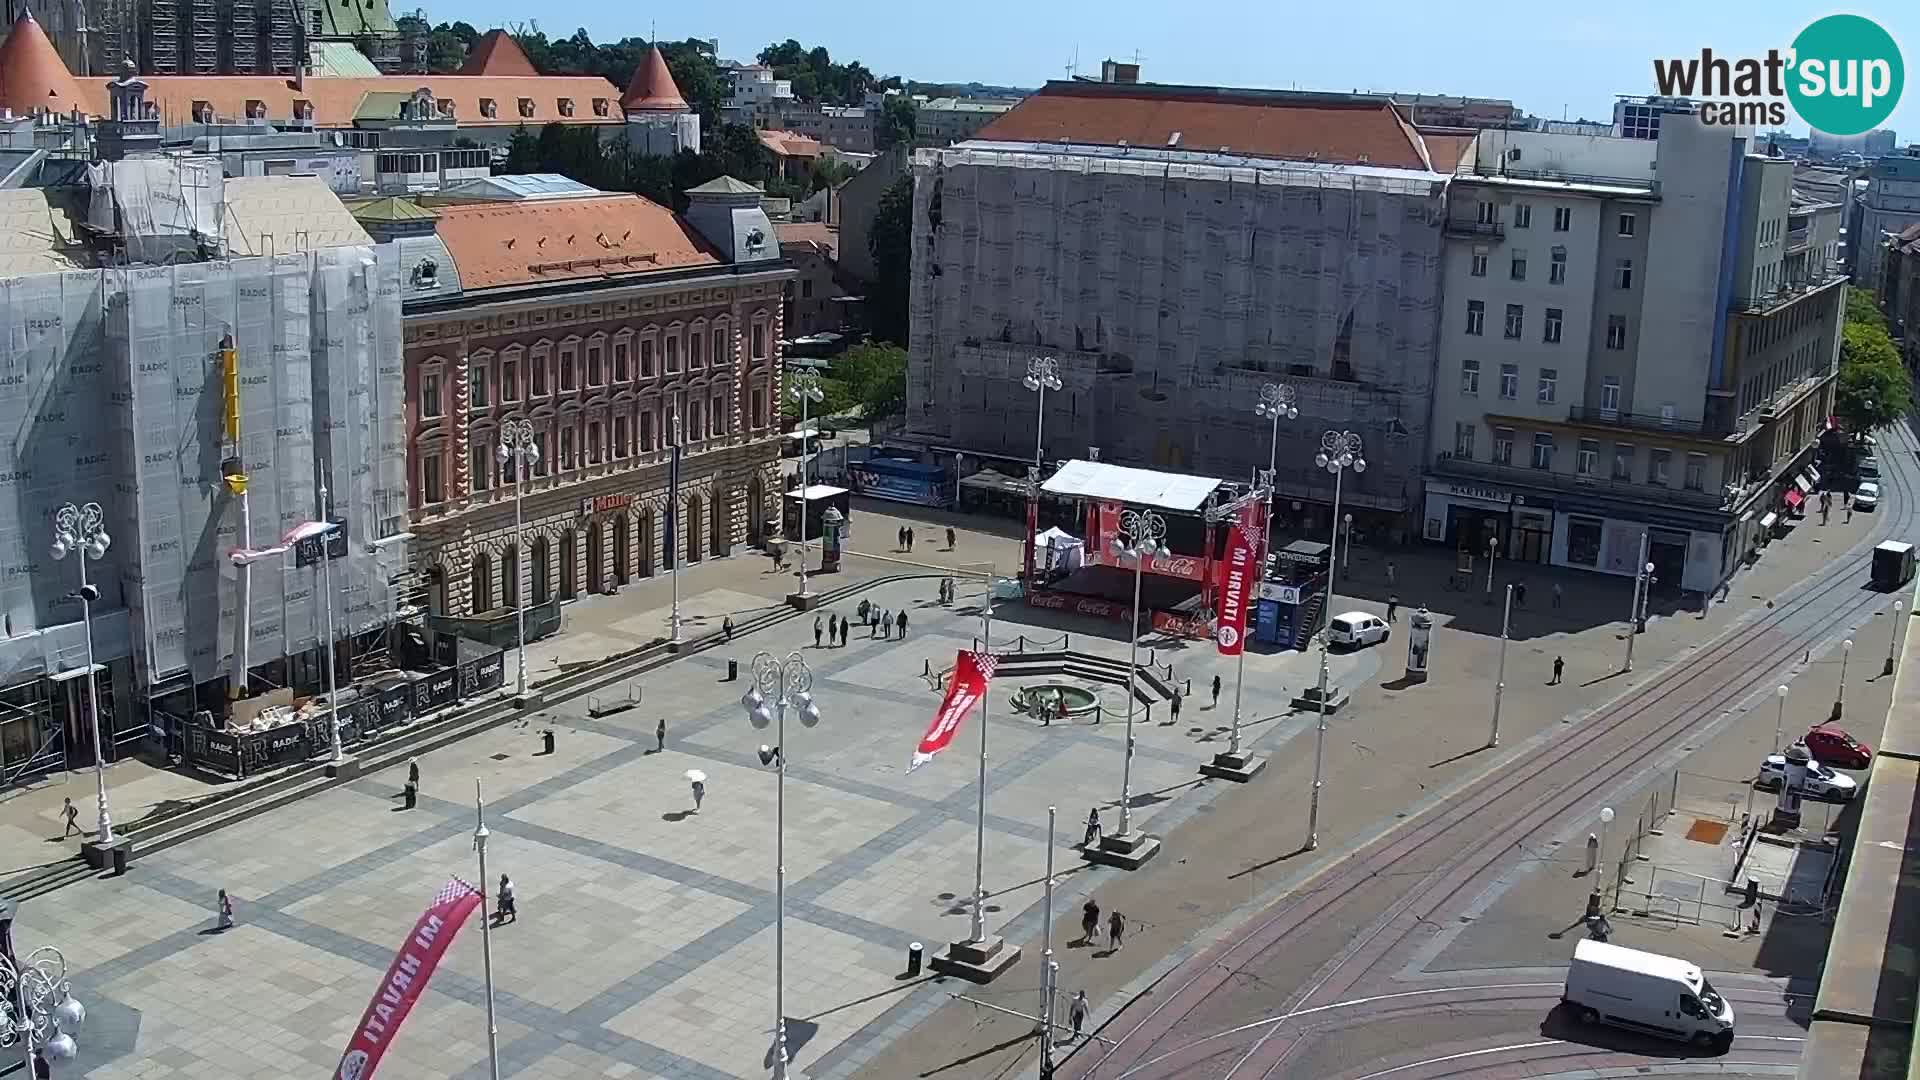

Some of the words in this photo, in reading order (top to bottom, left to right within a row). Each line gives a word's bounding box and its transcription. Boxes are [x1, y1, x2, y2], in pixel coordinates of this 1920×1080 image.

[1232, 547, 1247, 566] MI
[1223, 570, 1243, 622] HRVATI
[272, 735, 301, 749] RADIC
